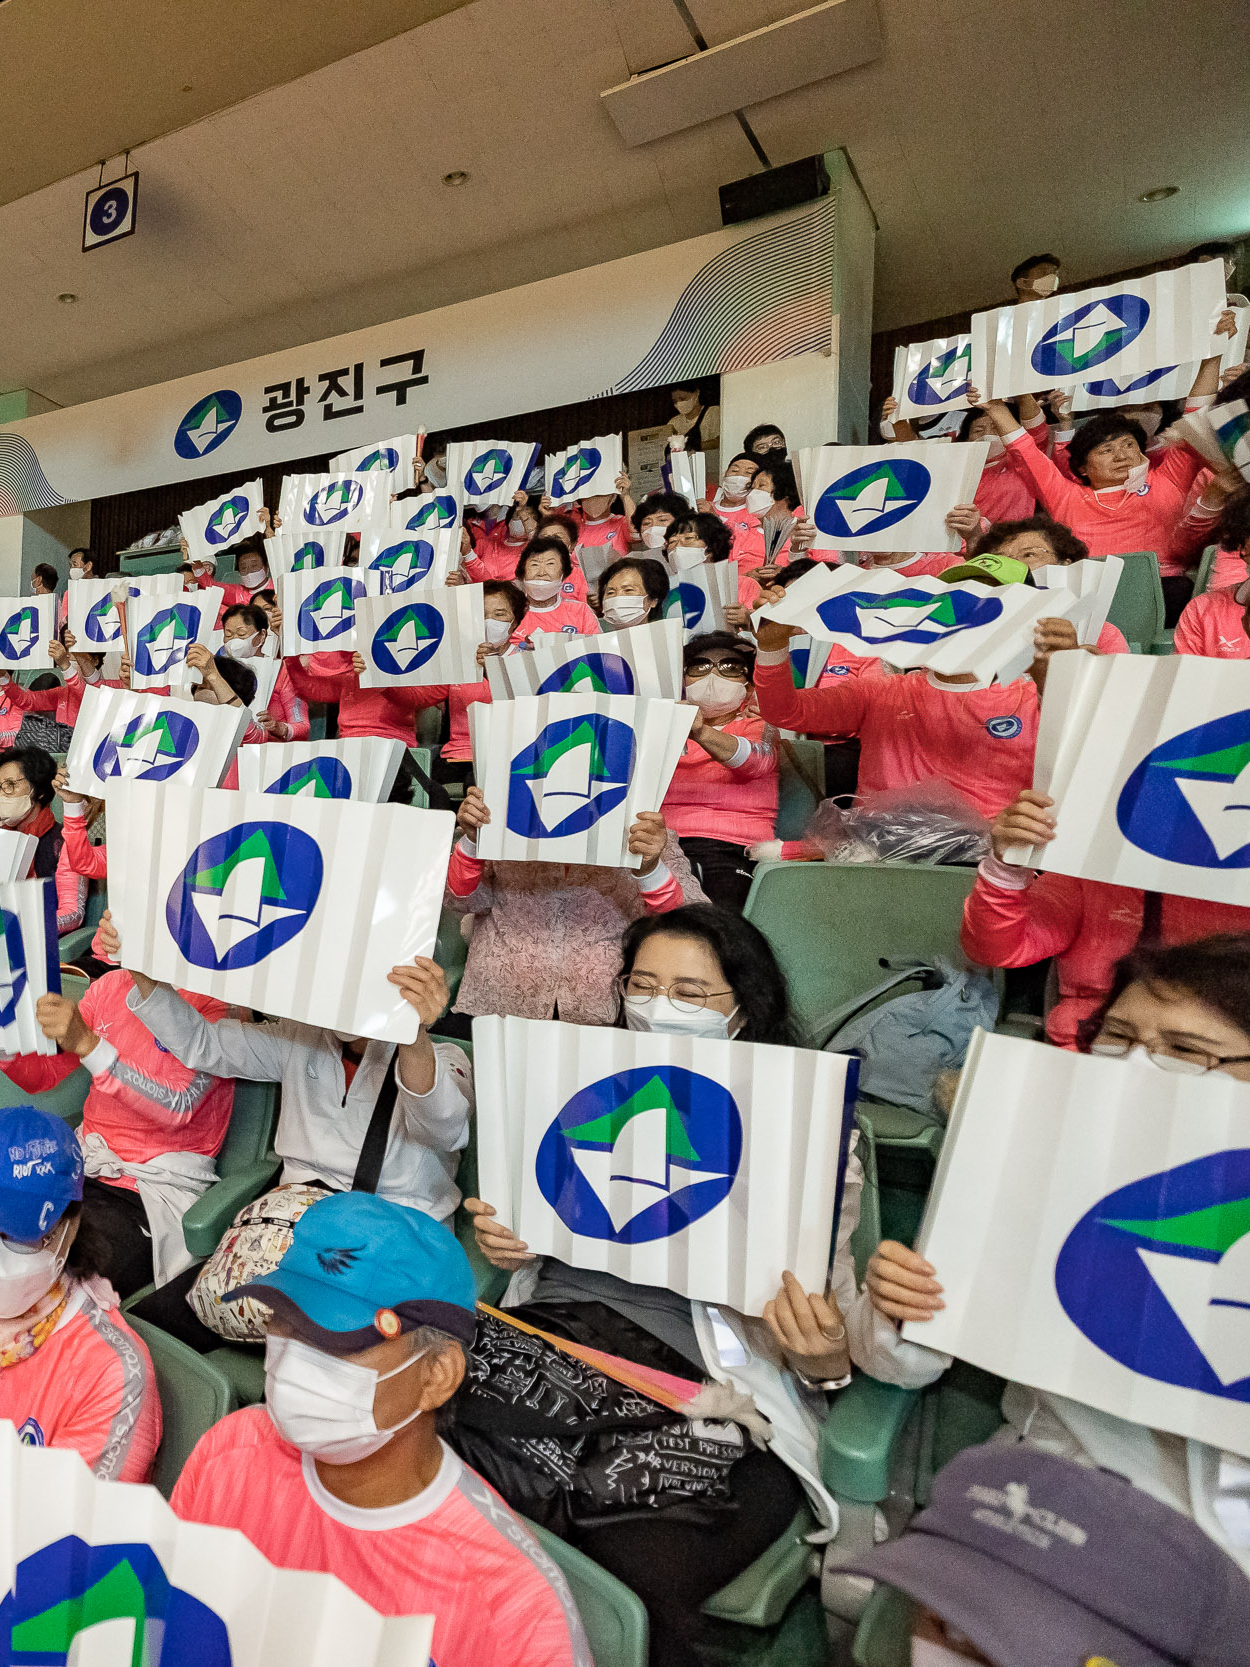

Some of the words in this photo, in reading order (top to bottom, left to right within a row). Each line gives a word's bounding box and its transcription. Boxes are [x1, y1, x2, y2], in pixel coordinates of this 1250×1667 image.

[102, 200, 117, 224] 3
[262, 349, 429, 433] 광진구
[13, 1159, 42, 1179] RIOT
[661, 1438, 691, 1450] TEST
[663, 1459, 720, 1479] VERSION
